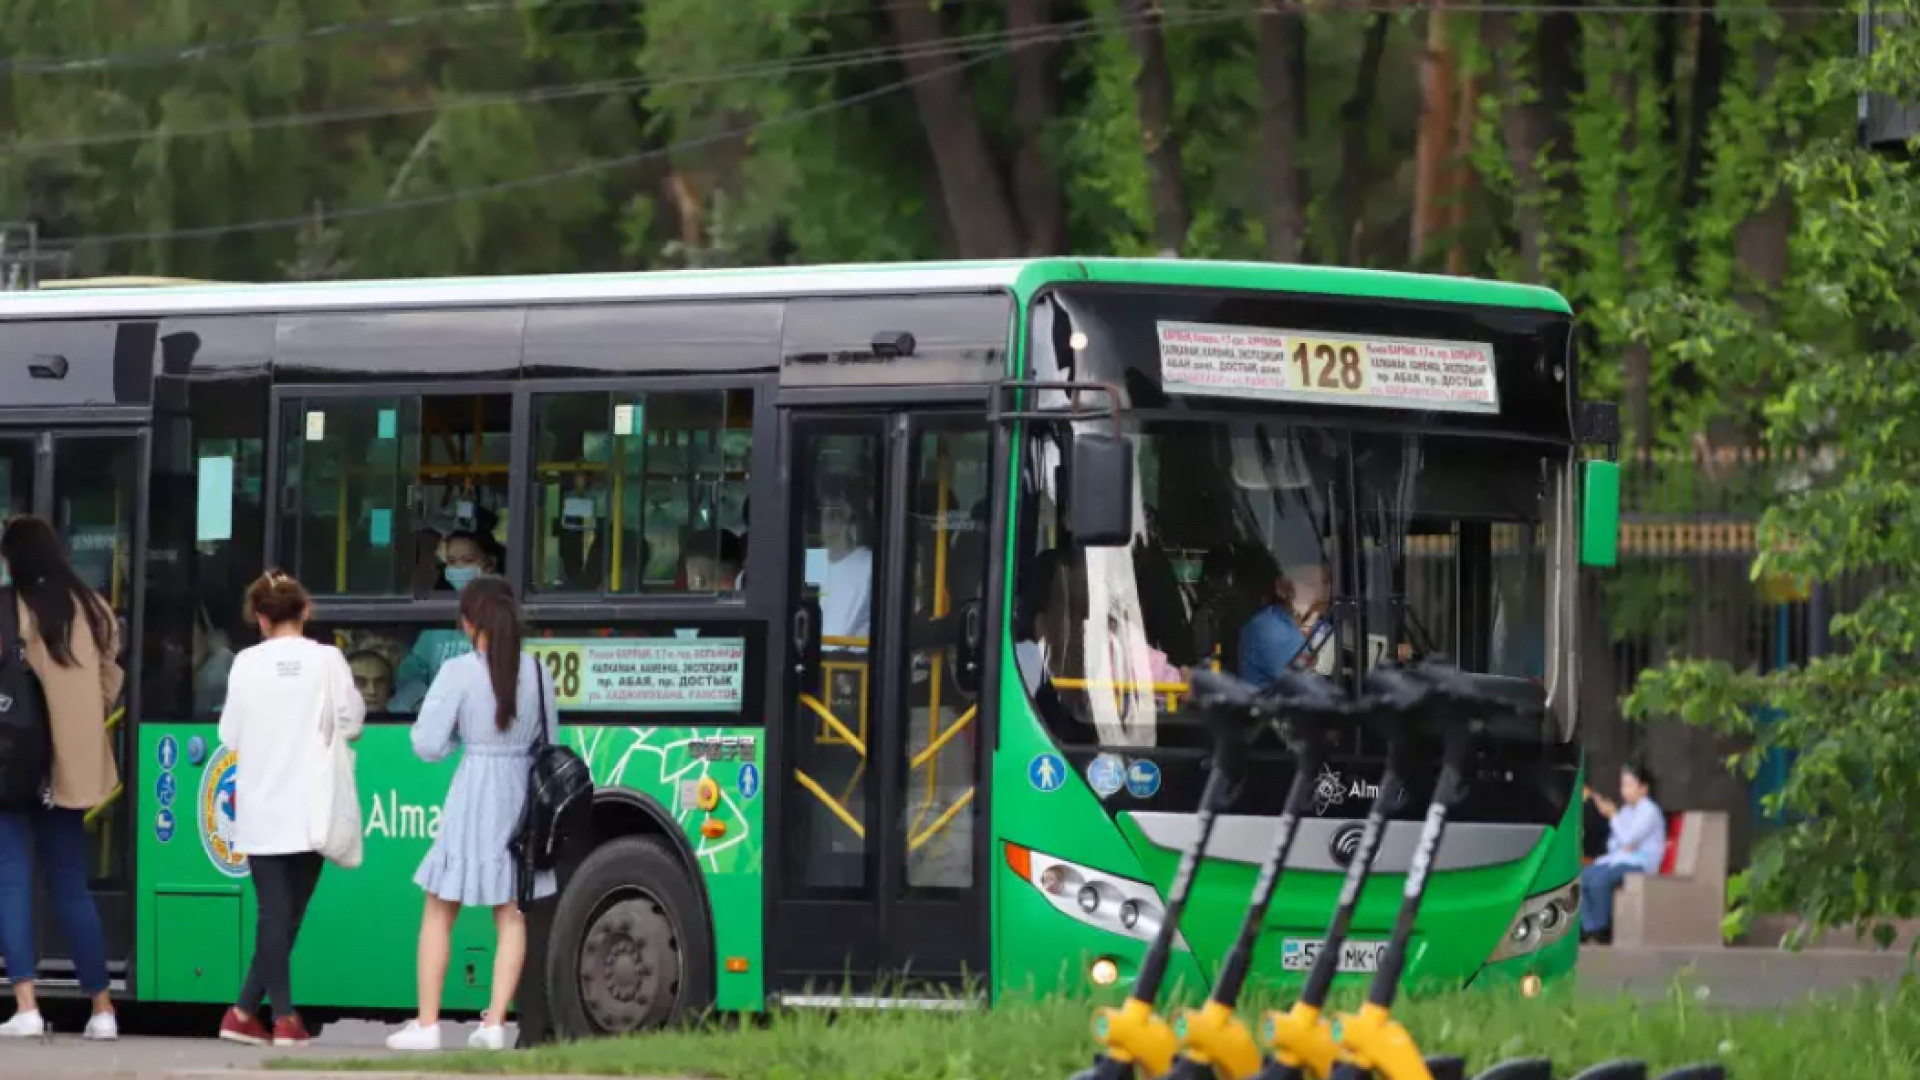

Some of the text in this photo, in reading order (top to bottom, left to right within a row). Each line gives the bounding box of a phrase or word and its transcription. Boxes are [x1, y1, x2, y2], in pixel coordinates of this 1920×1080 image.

[1293, 342, 1362, 390] 128
[534, 651, 580, 698] 28
[679, 674, 733, 689] ДОСТЫК
[365, 788, 443, 839] Alma
